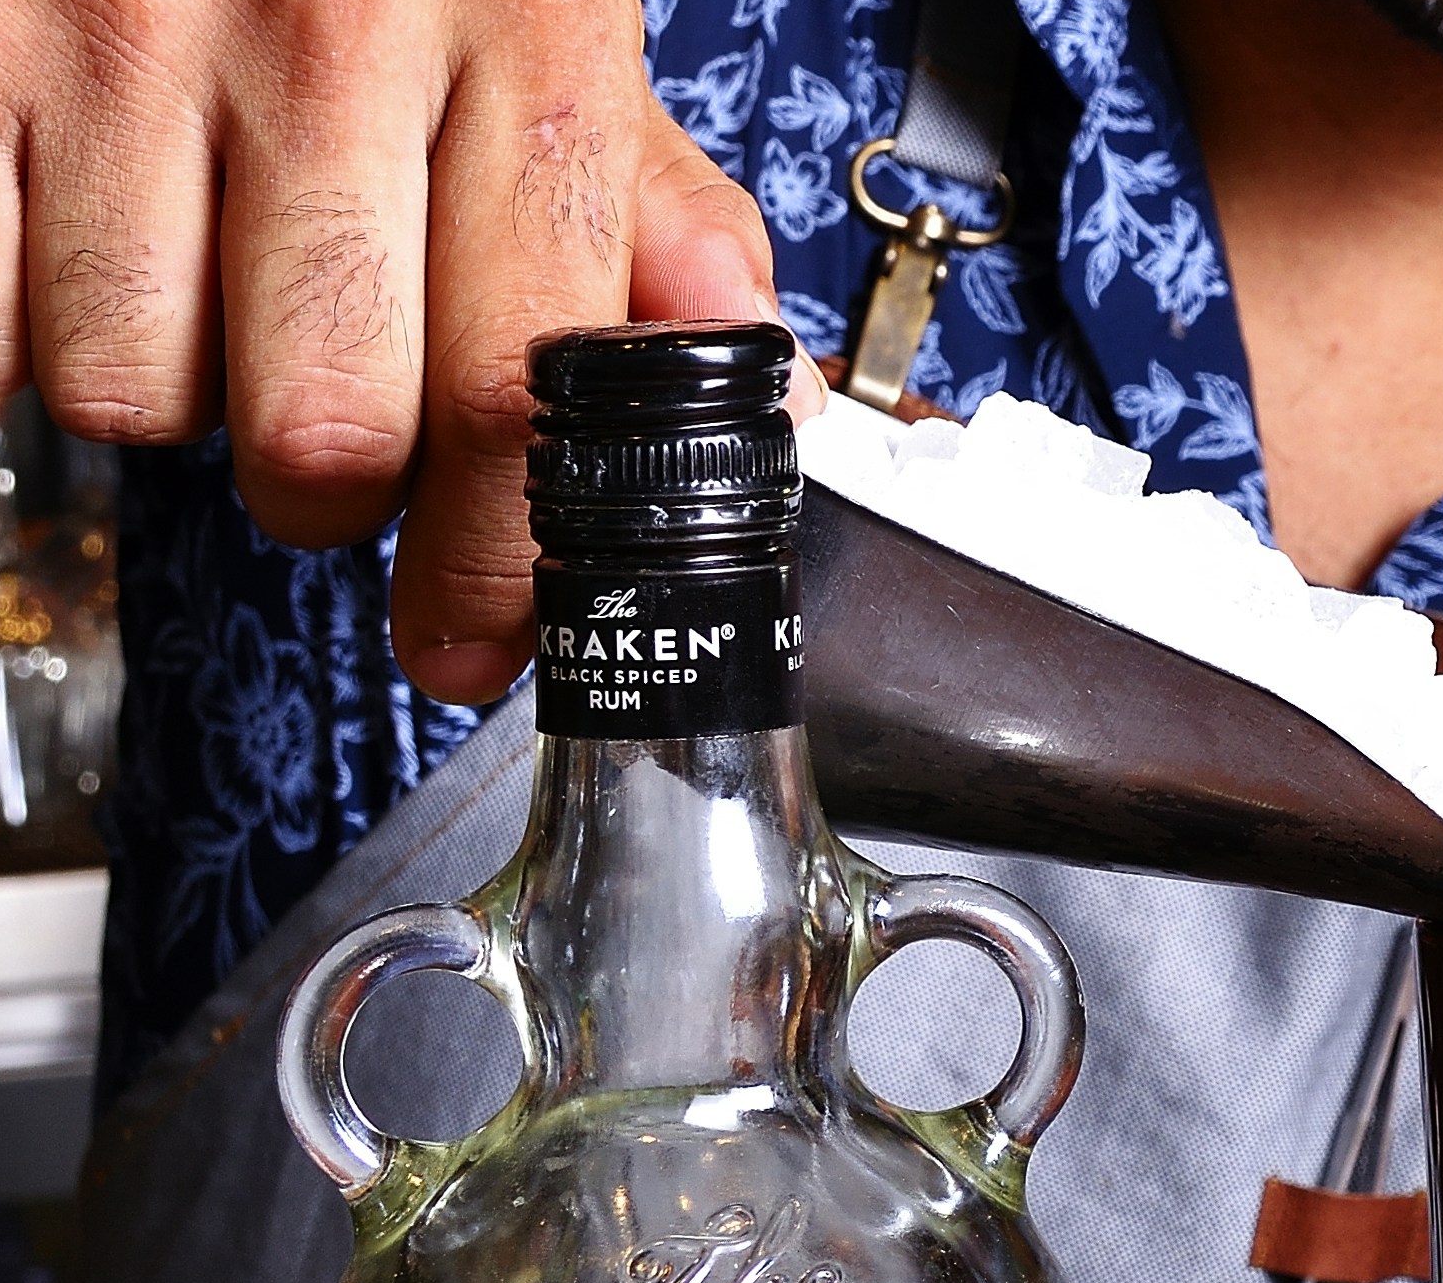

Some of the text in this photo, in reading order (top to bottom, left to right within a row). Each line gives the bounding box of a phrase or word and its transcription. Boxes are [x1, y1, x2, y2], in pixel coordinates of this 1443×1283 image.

[588, 587, 638, 619] The
[551, 664, 698, 684] BLACK SPICED
[589, 690, 641, 710] RUM
